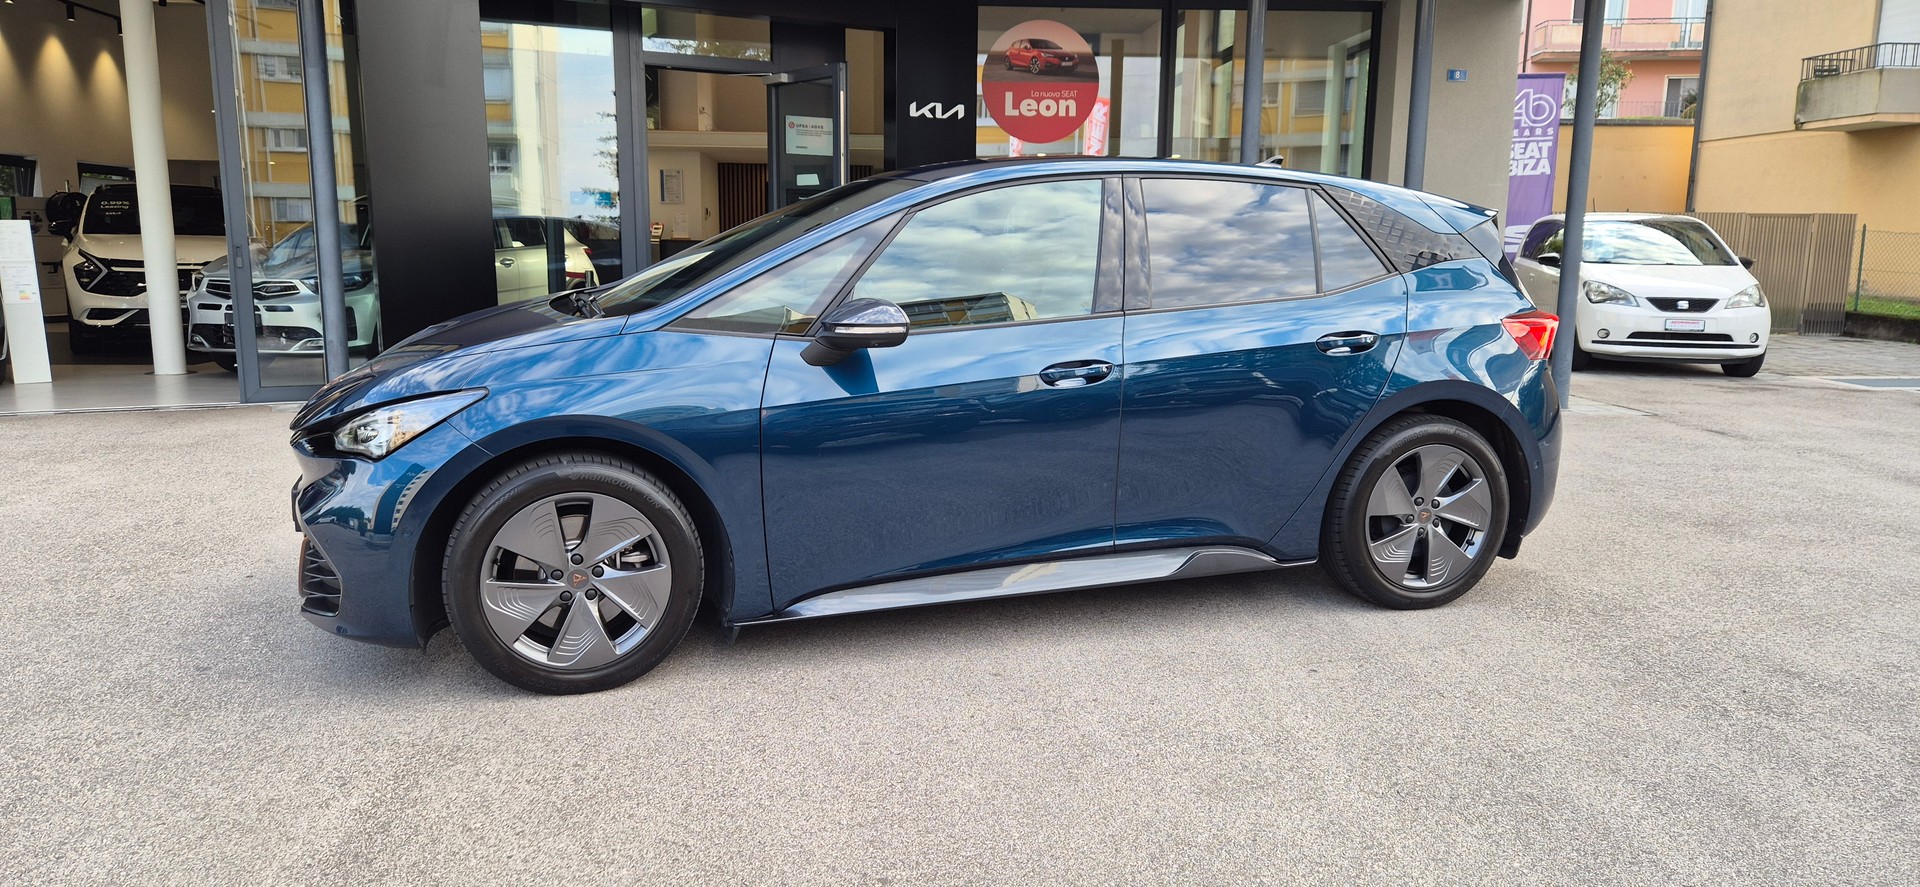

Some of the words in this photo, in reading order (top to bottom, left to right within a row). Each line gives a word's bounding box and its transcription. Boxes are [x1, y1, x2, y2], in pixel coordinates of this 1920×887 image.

[909, 101, 965, 120] KIA
[1005, 91, 1077, 117] Leon
[1513, 127, 1554, 137] EARS
[1508, 158, 1551, 176] BIZA
